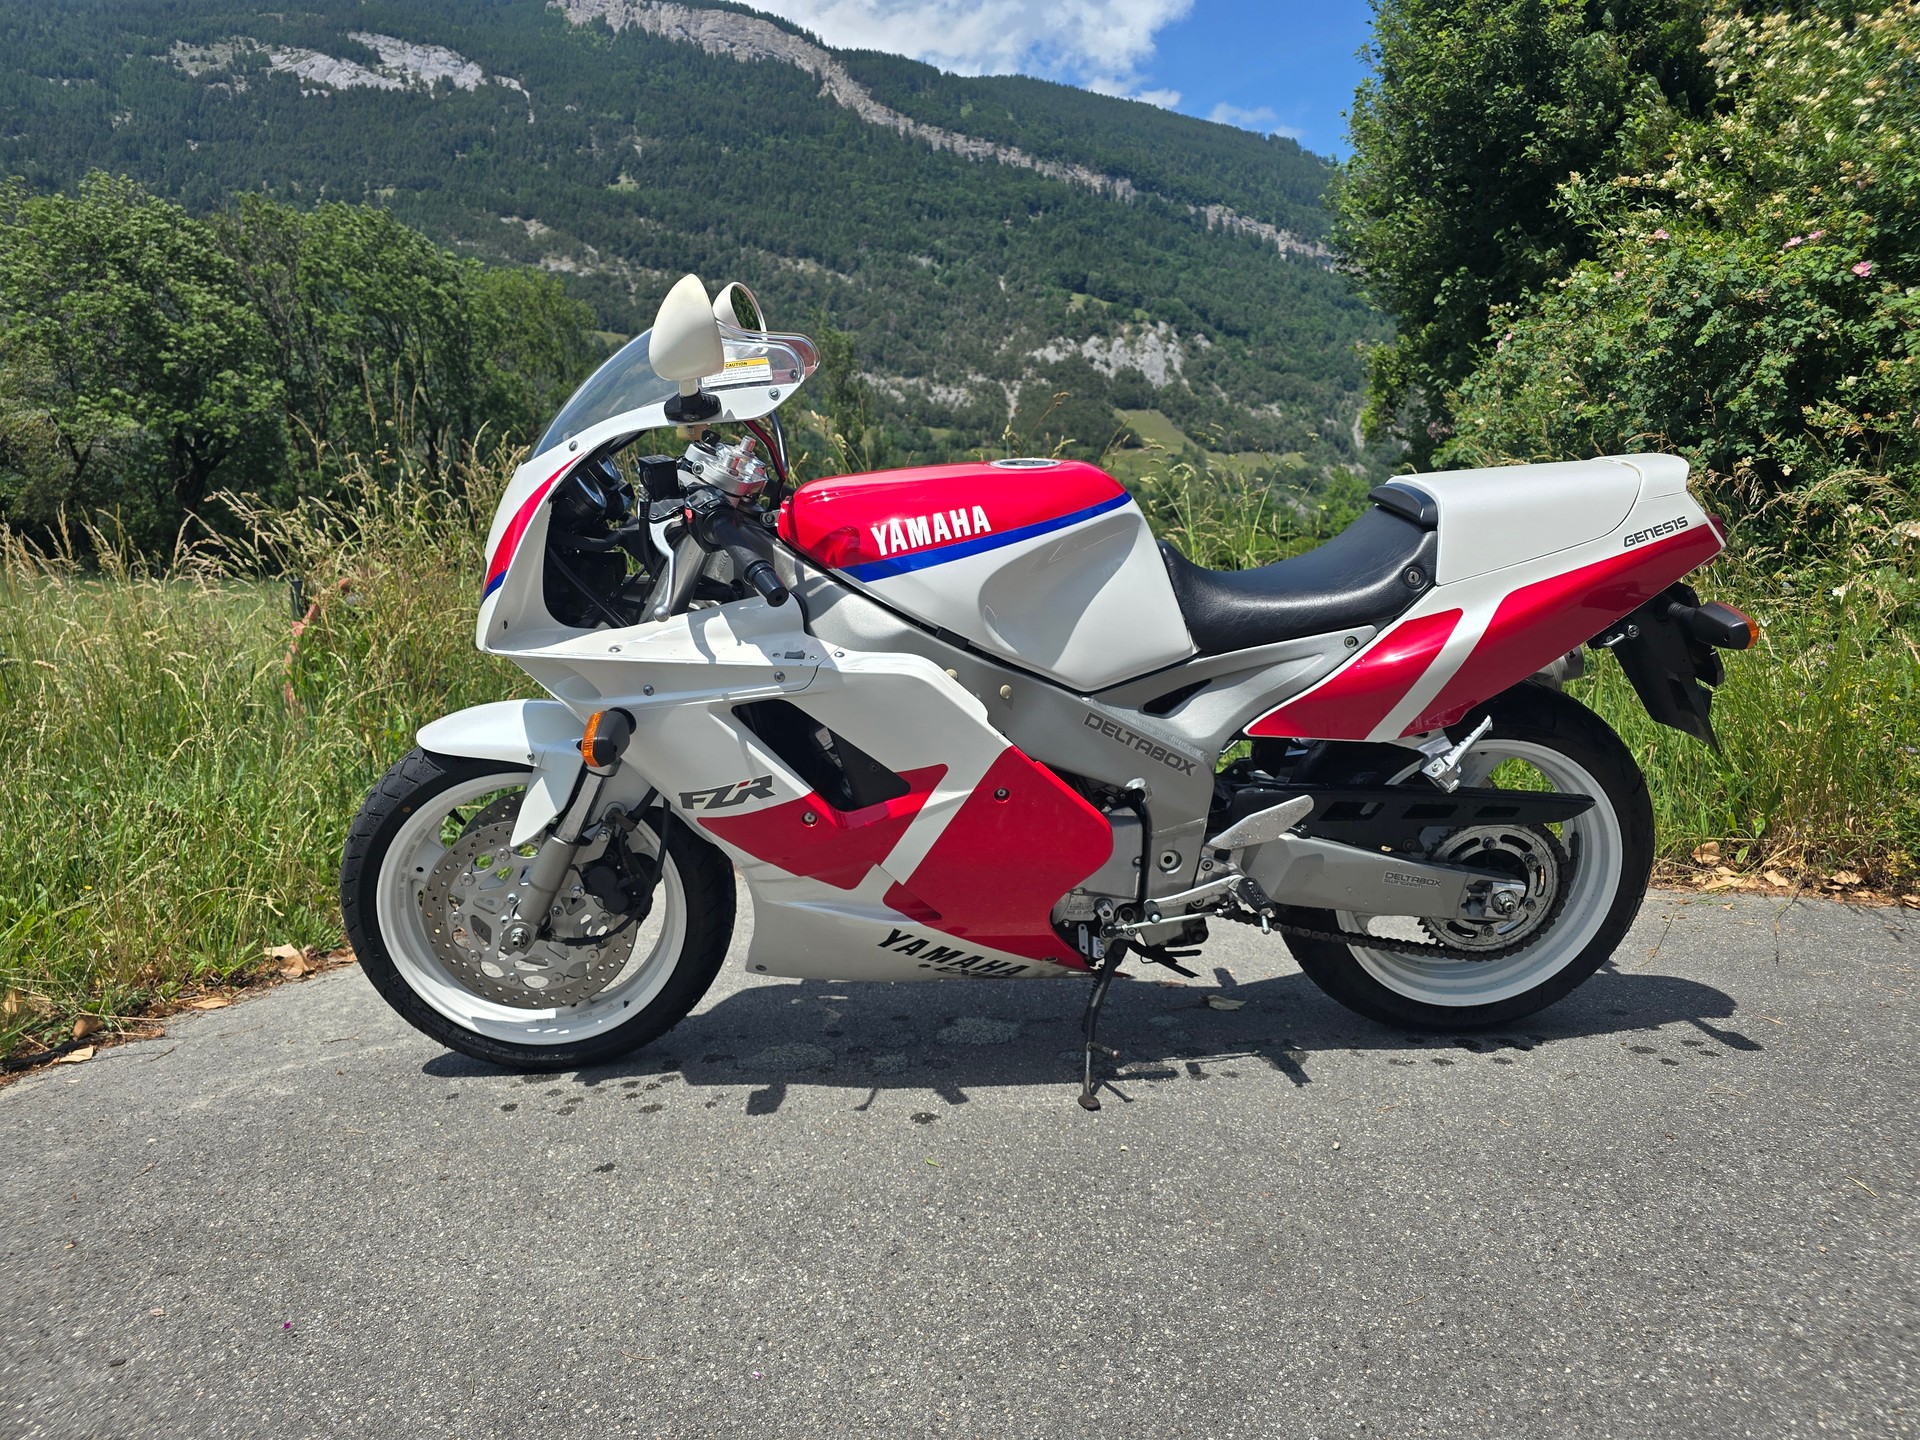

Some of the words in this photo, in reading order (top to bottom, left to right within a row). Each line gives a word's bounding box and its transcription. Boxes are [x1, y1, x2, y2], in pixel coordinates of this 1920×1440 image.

[870, 505, 992, 556] YAMAHA
[1623, 516, 1688, 547] GENESIS
[1083, 712, 1197, 777] DELTABOX
[678, 774, 776, 809] FZR
[1384, 872, 1441, 888] DELTABOX
[877, 928, 1031, 976] YAMAHA
